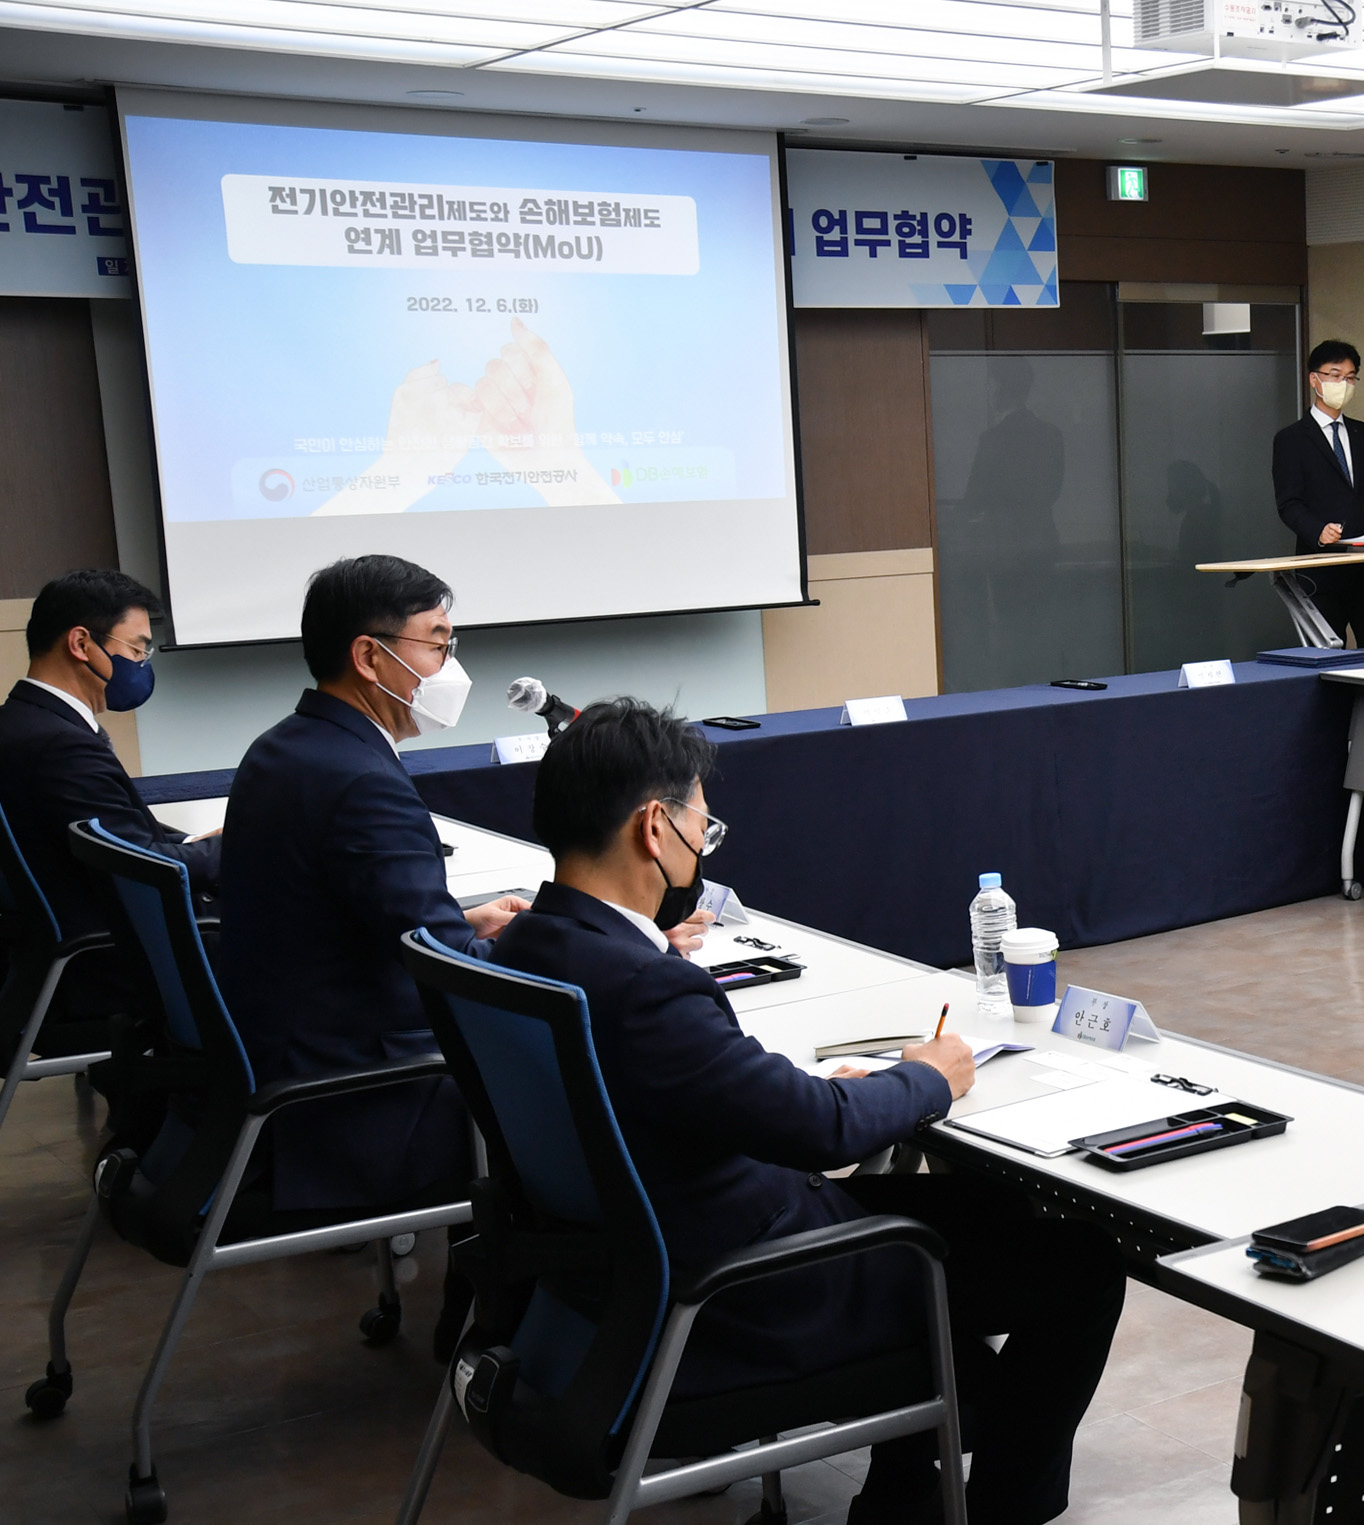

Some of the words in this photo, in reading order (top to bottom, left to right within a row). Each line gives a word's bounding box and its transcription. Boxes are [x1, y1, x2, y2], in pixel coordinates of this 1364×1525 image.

[268, 186, 510, 223] 전기안전관리제도와
[519, 198, 661, 228] 손해보험제도
[345, 226, 402, 255] 연계
[412, 229, 603, 261] 업무협약(MoU)
[811, 208, 973, 260] 업무협약
[407, 297, 458, 312] 2022.
[466, 298, 491, 313] 12.
[496, 298, 539, 314] 6.(화)
[293, 437, 336, 453] 국민이
[339, 436, 393, 452] 안심하는
[631, 431, 656, 445] 모두
[474, 469, 578, 486] 한국전기안전공사
[1074, 1010, 1112, 1032] 안근호
